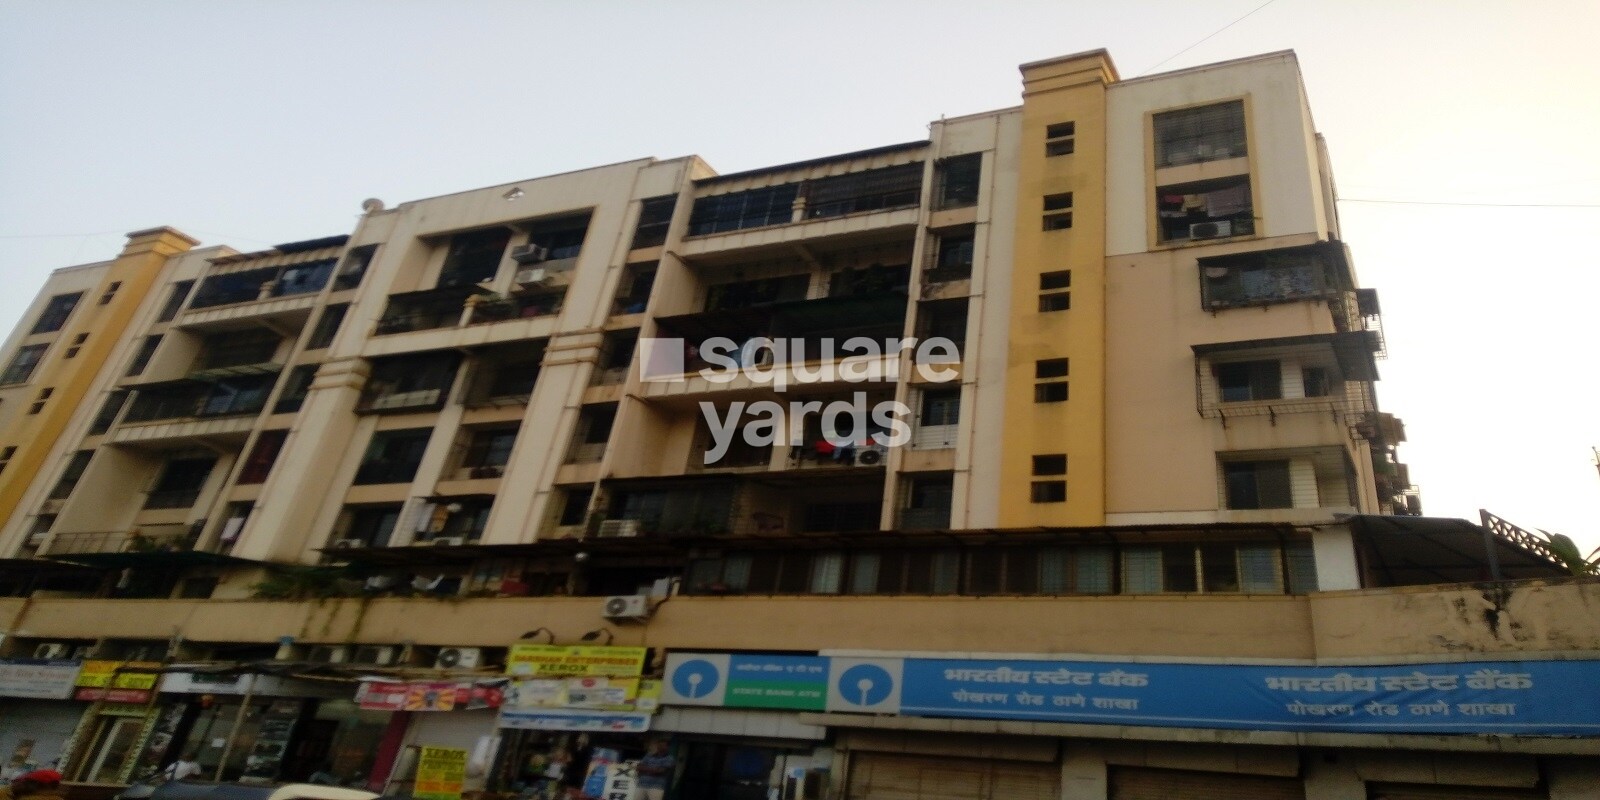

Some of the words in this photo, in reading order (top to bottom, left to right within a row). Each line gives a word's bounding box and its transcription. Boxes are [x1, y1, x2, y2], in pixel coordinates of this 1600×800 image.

[538, 664, 589, 672] XEROX
[943, 667, 1032, 683] भारतीय
[1032, 668, 1094, 686] स्टेट
[1264, 672, 1377, 692] भारतीय
[1378, 671, 1459, 691] स्टेट
[1464, 668, 1534, 690] बैंक
[732, 687, 763, 696] STATE
[765, 688, 795, 697] BANK
[1364, 700, 1400, 716] रोड
[1408, 699, 1450, 716] ठाणे
[1457, 702, 1517, 716] शाखा
[423, 747, 467, 760] XEROX
